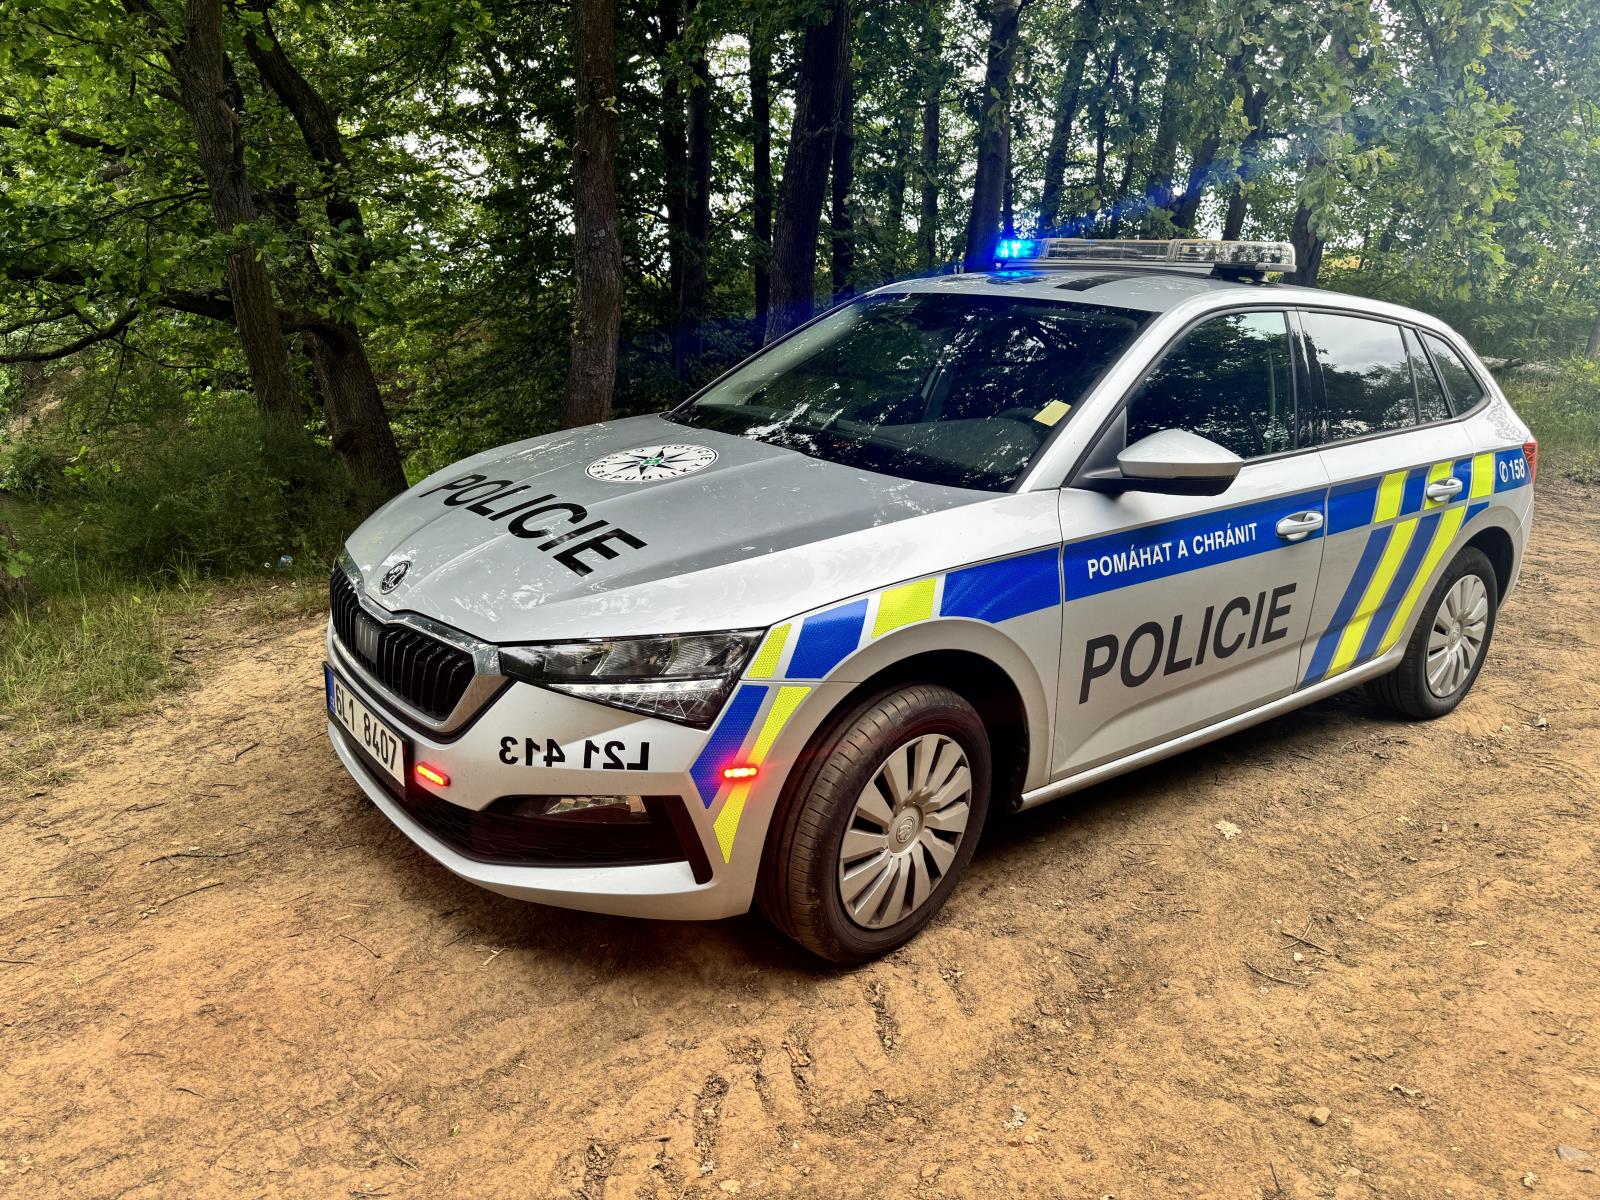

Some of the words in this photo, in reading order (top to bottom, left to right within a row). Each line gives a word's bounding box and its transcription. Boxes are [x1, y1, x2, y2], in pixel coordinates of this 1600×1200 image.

[1509, 457, 1526, 480] 158
[418, 474, 648, 577] POLICIE
[1087, 544, 1172, 579] POMÁHAT
[1178, 539, 1188, 559] A
[1192, 523, 1258, 555] CHRÁNIT
[1079, 582, 1297, 705] POLICIE
[336, 683, 356, 732] 6L1
[363, 712, 397, 771] 8407
